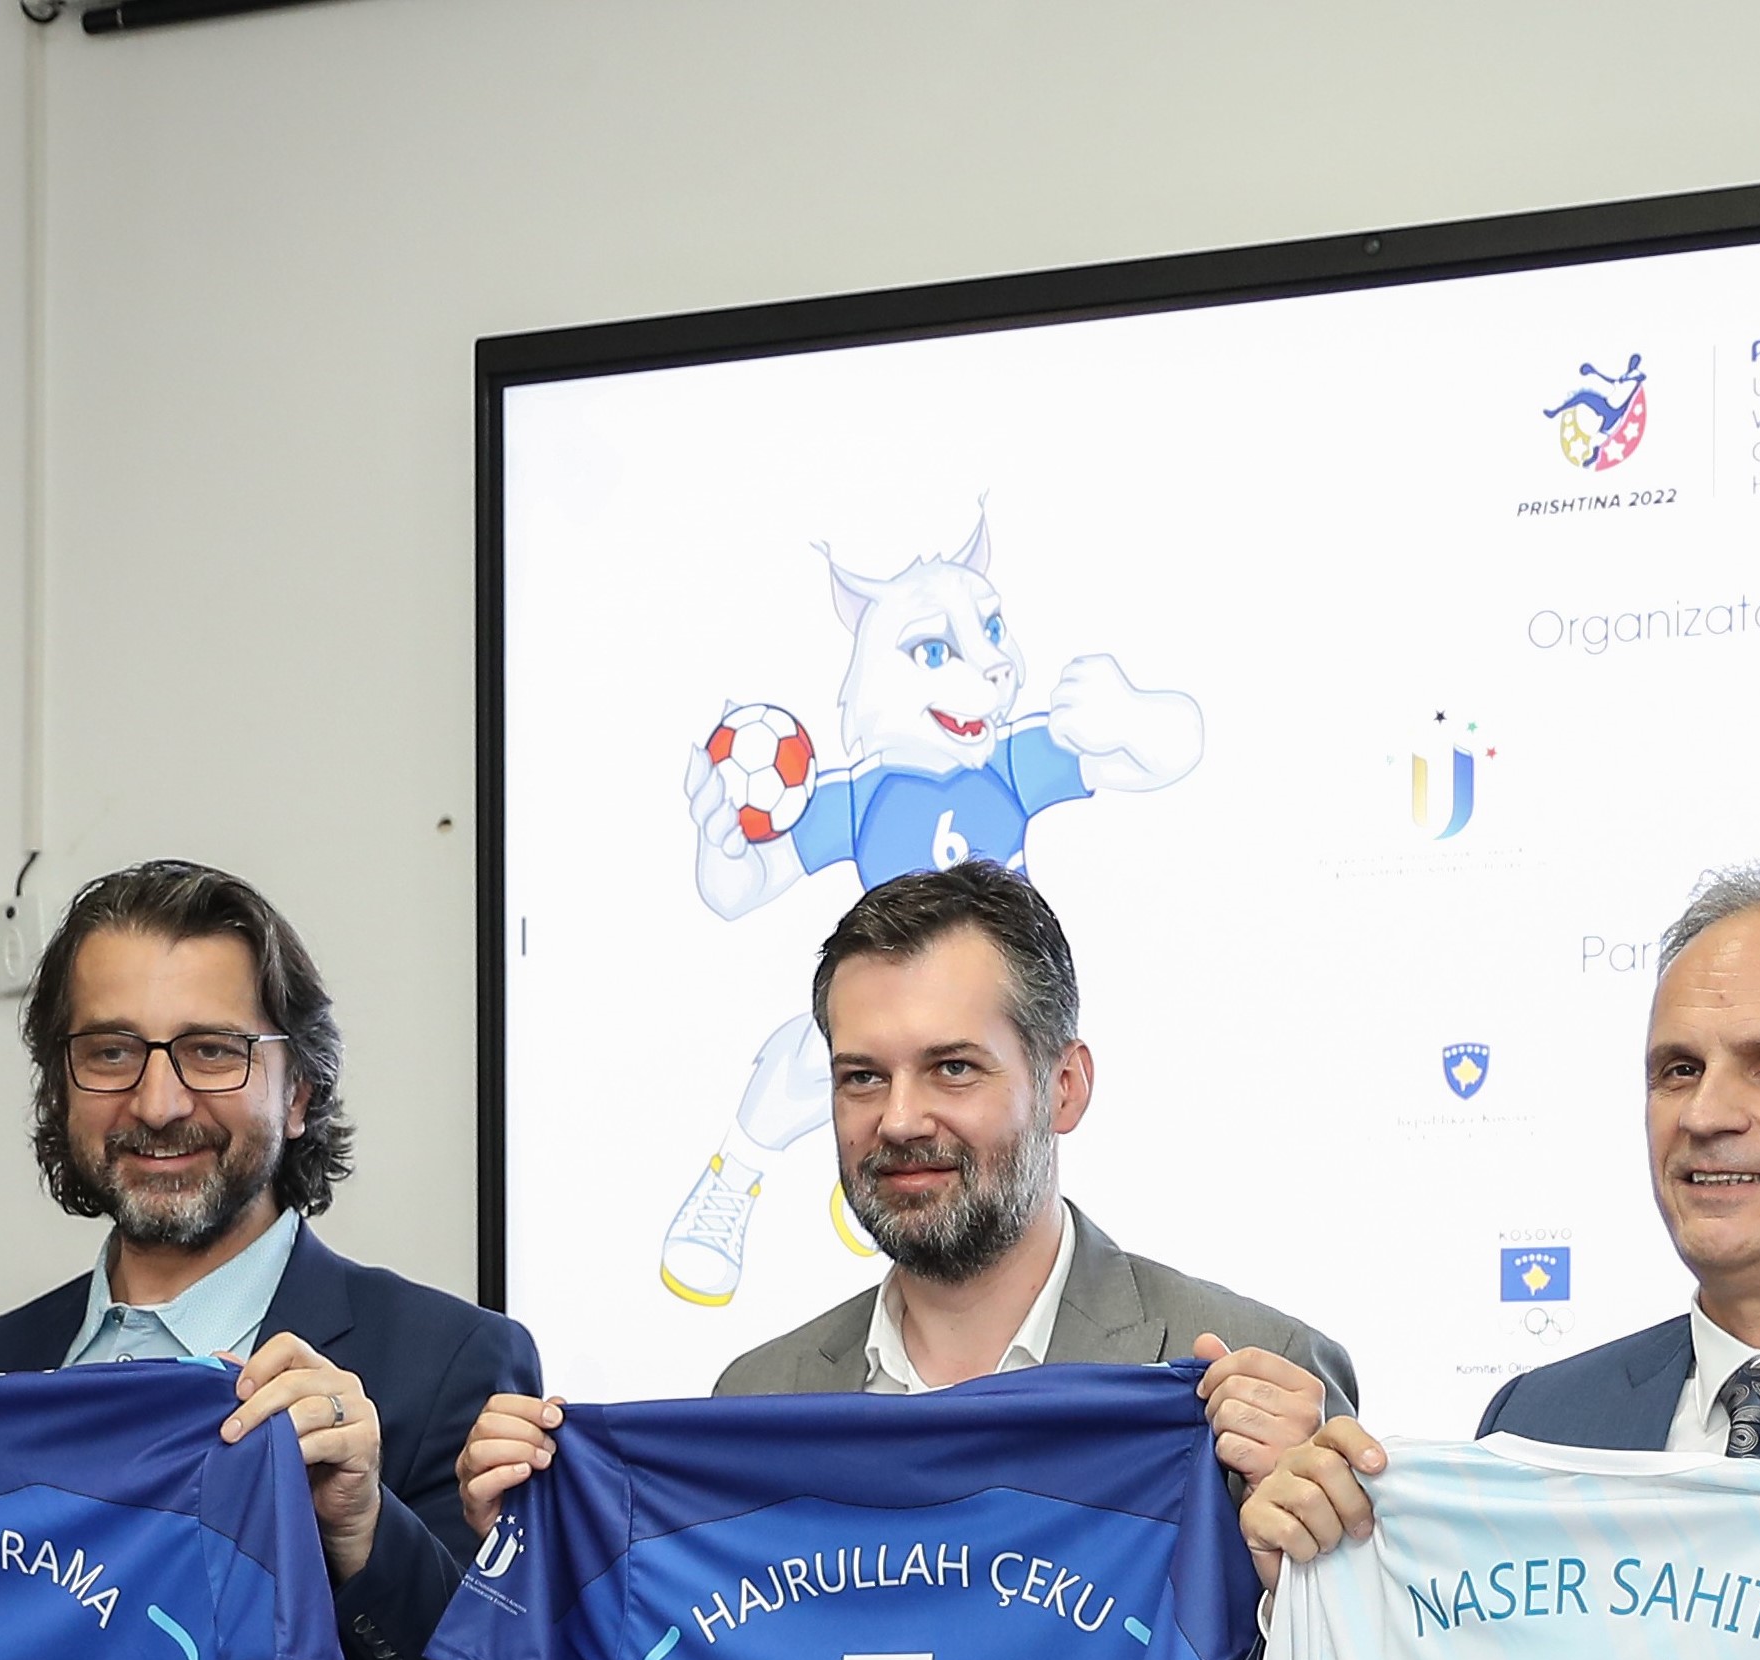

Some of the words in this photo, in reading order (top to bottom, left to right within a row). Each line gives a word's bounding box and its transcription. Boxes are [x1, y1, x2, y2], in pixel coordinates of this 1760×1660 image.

[1517, 494, 1621, 517] PRISHTINA
[1628, 488, 1678, 507] 2022
[932, 808, 969, 870] 6
[0, 1528, 121, 1630] RAMA
[691, 1542, 971, 1645] HAJRULLAH
[989, 1551, 1116, 1635] ÇEKU
[1405, 1557, 1587, 1639] NASER
